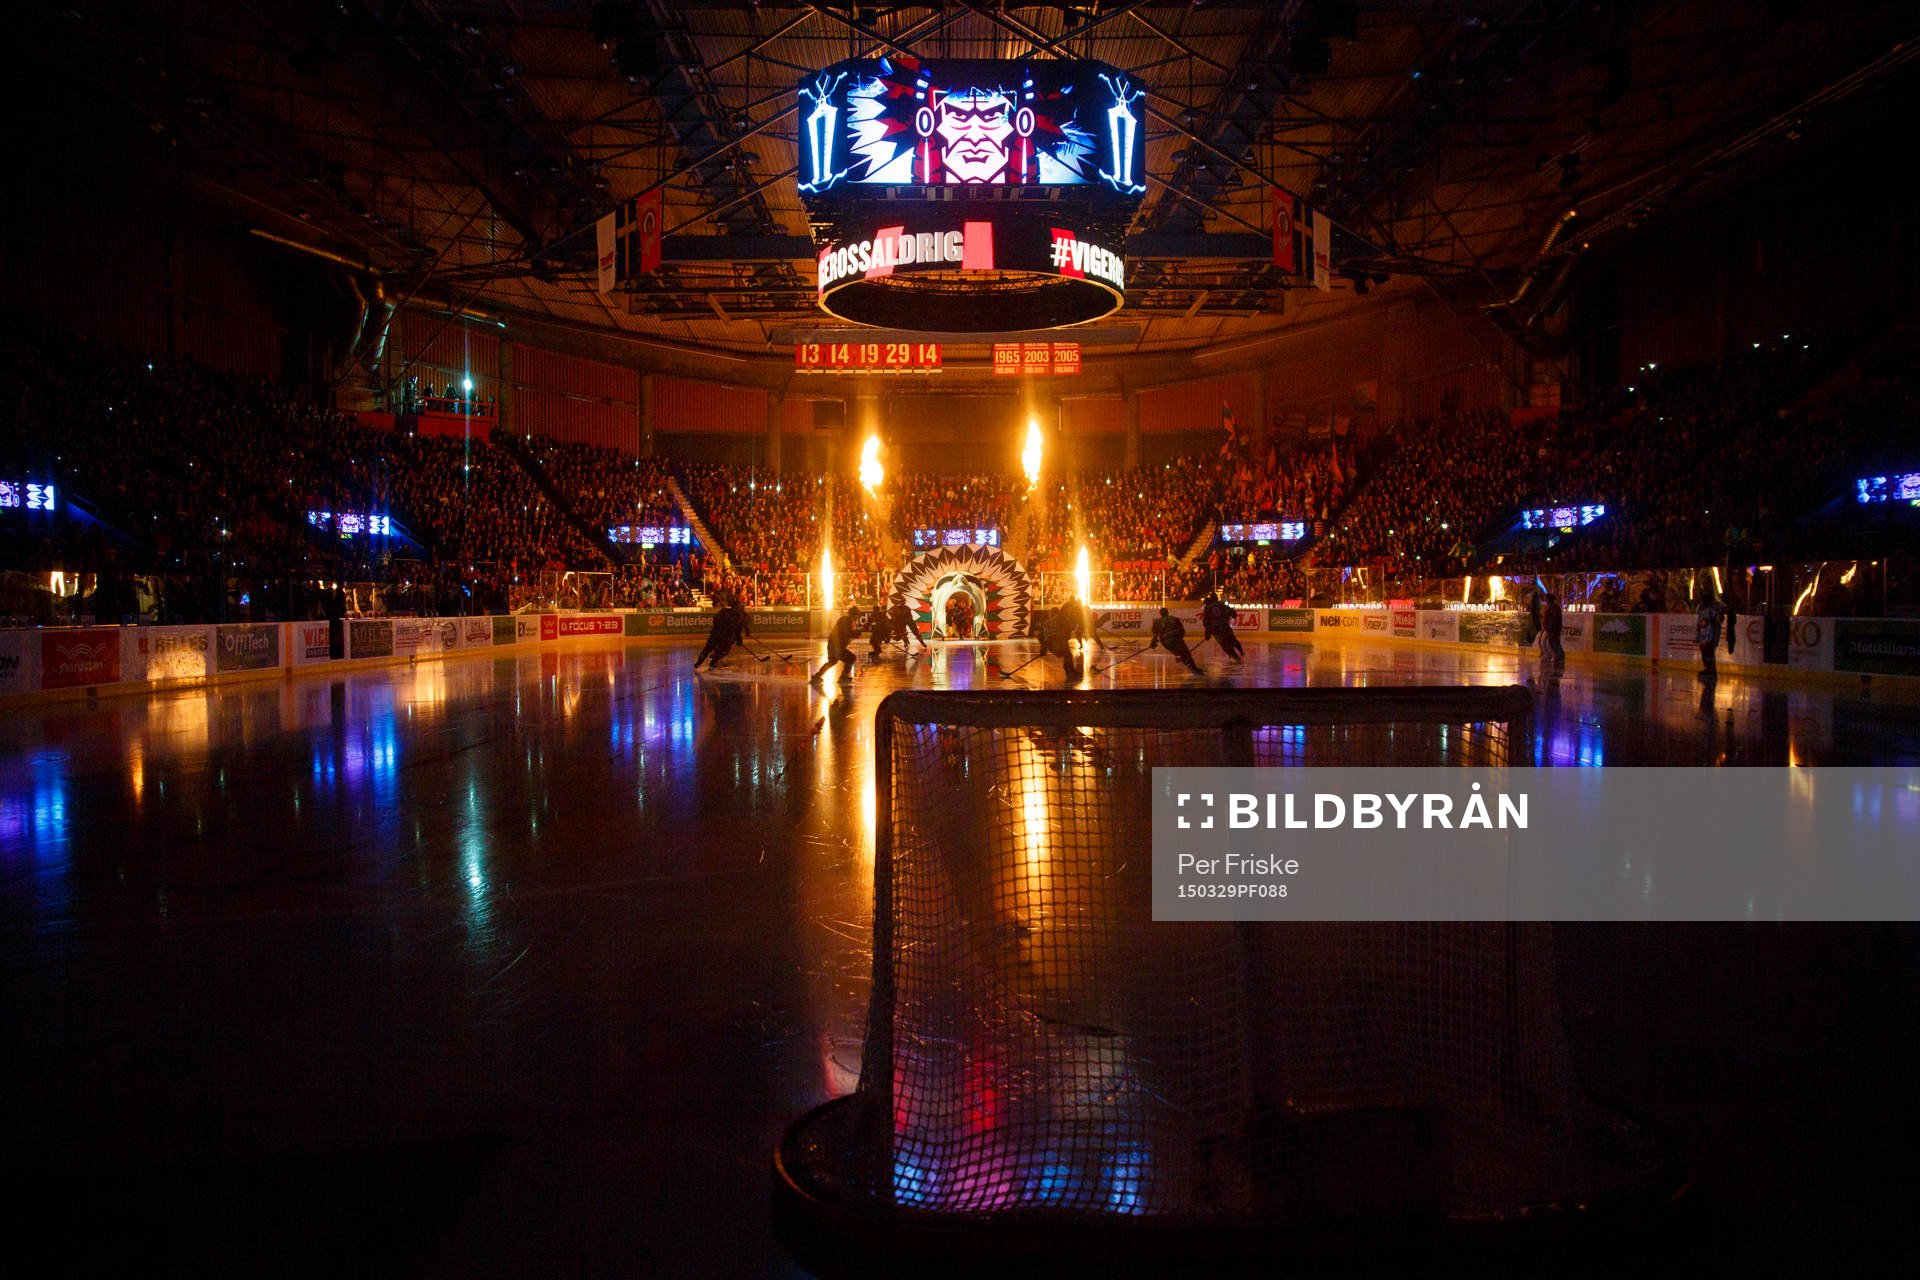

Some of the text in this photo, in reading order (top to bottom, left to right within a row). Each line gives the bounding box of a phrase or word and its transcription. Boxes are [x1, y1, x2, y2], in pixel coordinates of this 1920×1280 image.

[801, 344, 819, 363] 13
[831, 344, 849, 363] 14
[861, 344, 878, 363] 19
[886, 344, 909, 363] 29
[919, 343, 937, 363] 14
[995, 350, 1020, 363] 1965
[1024, 350, 1049, 363] 2003
[1054, 349, 1079, 362] 2005
[649, 615, 713, 626] GP Batteries
[754, 615, 804, 625] Batteries
[1112, 612, 1141, 621] INTER
[569, 621, 595, 631] FOCUS
[1112, 621, 1142, 629] SPORT
